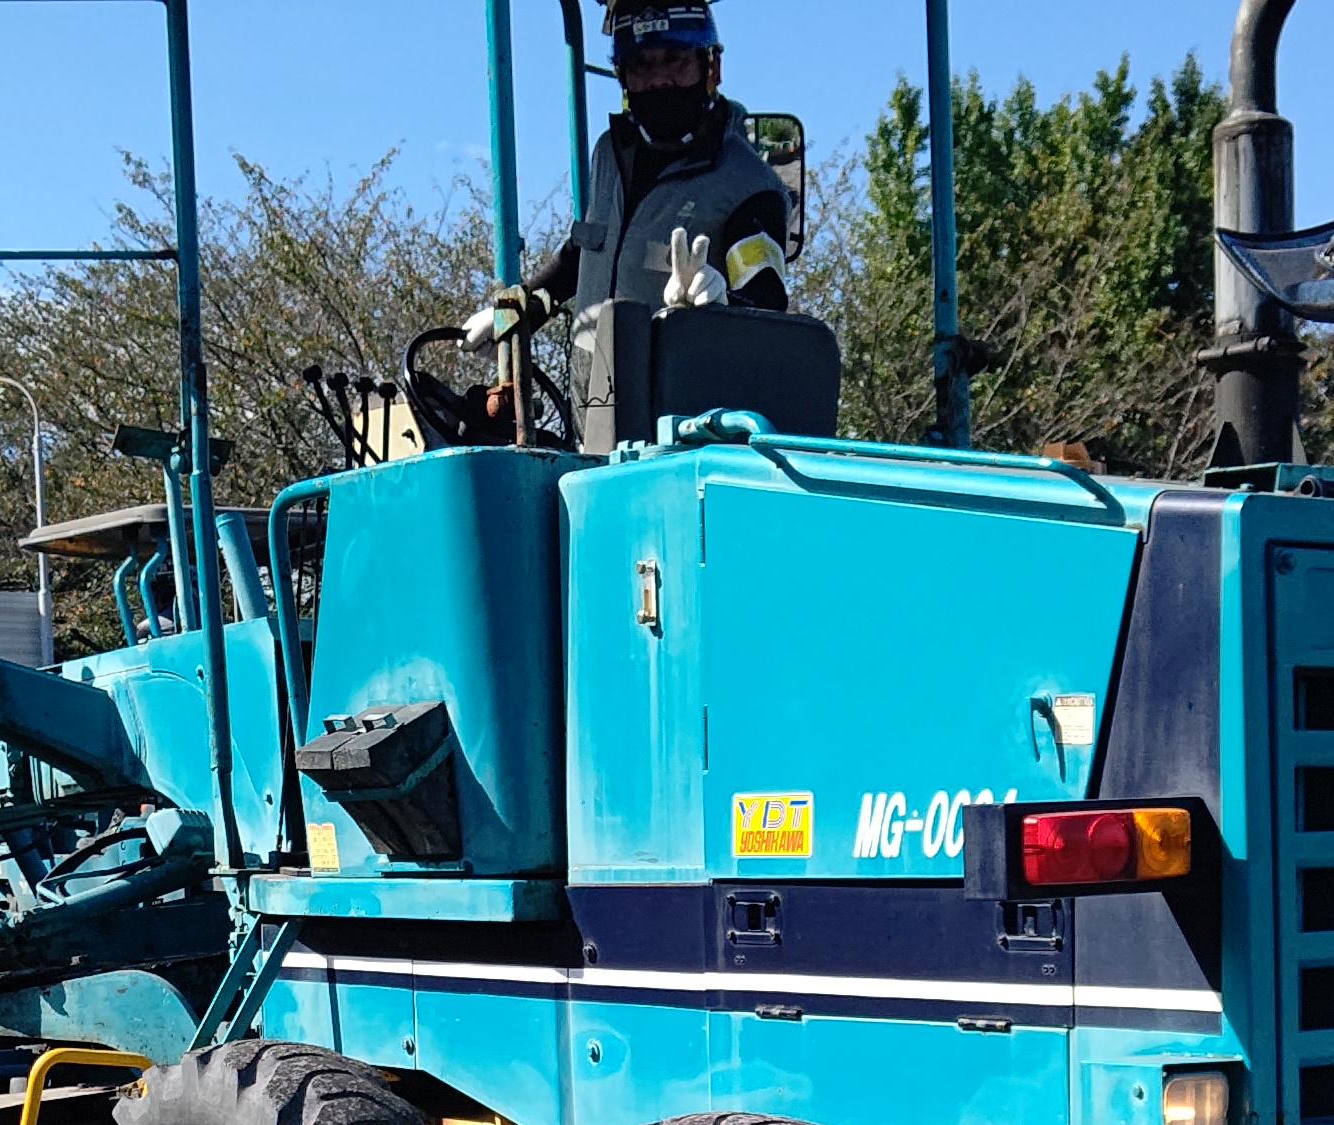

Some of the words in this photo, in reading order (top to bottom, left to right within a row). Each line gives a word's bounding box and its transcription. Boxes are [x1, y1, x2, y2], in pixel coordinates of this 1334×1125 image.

[738, 799, 809, 830] YDT
[853, 788, 1018, 859] MG-00
[740, 829, 804, 853] YOSHIKAWA
